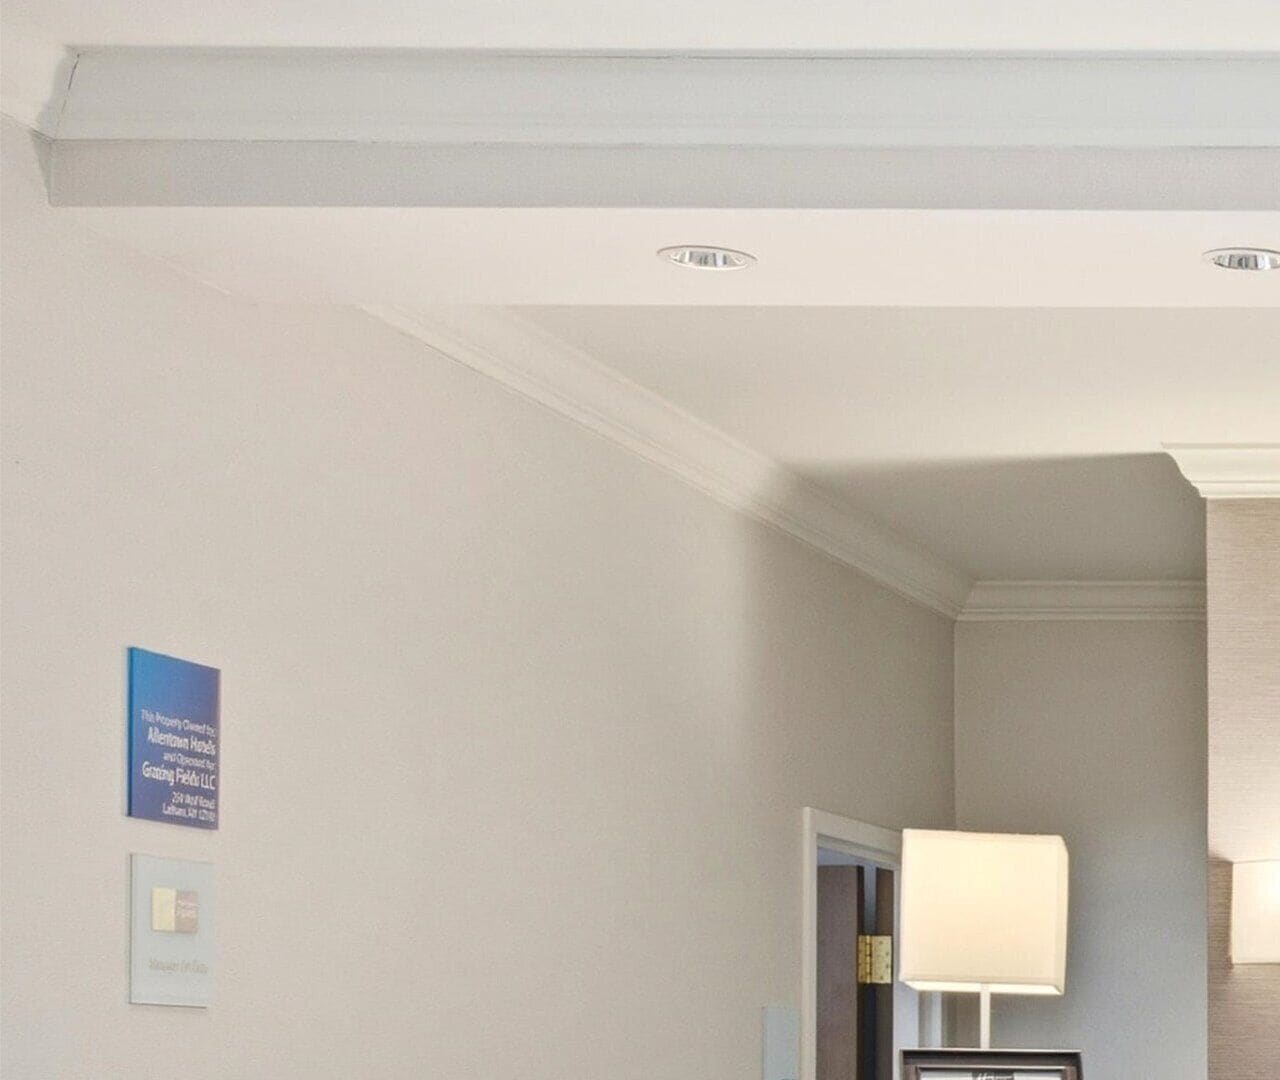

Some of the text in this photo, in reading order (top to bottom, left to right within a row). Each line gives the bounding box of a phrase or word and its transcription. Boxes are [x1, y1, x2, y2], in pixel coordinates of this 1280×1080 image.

[148, 727, 216, 756] Allentown Hotels
[142, 761, 216, 790] Grazing Fields LLC
